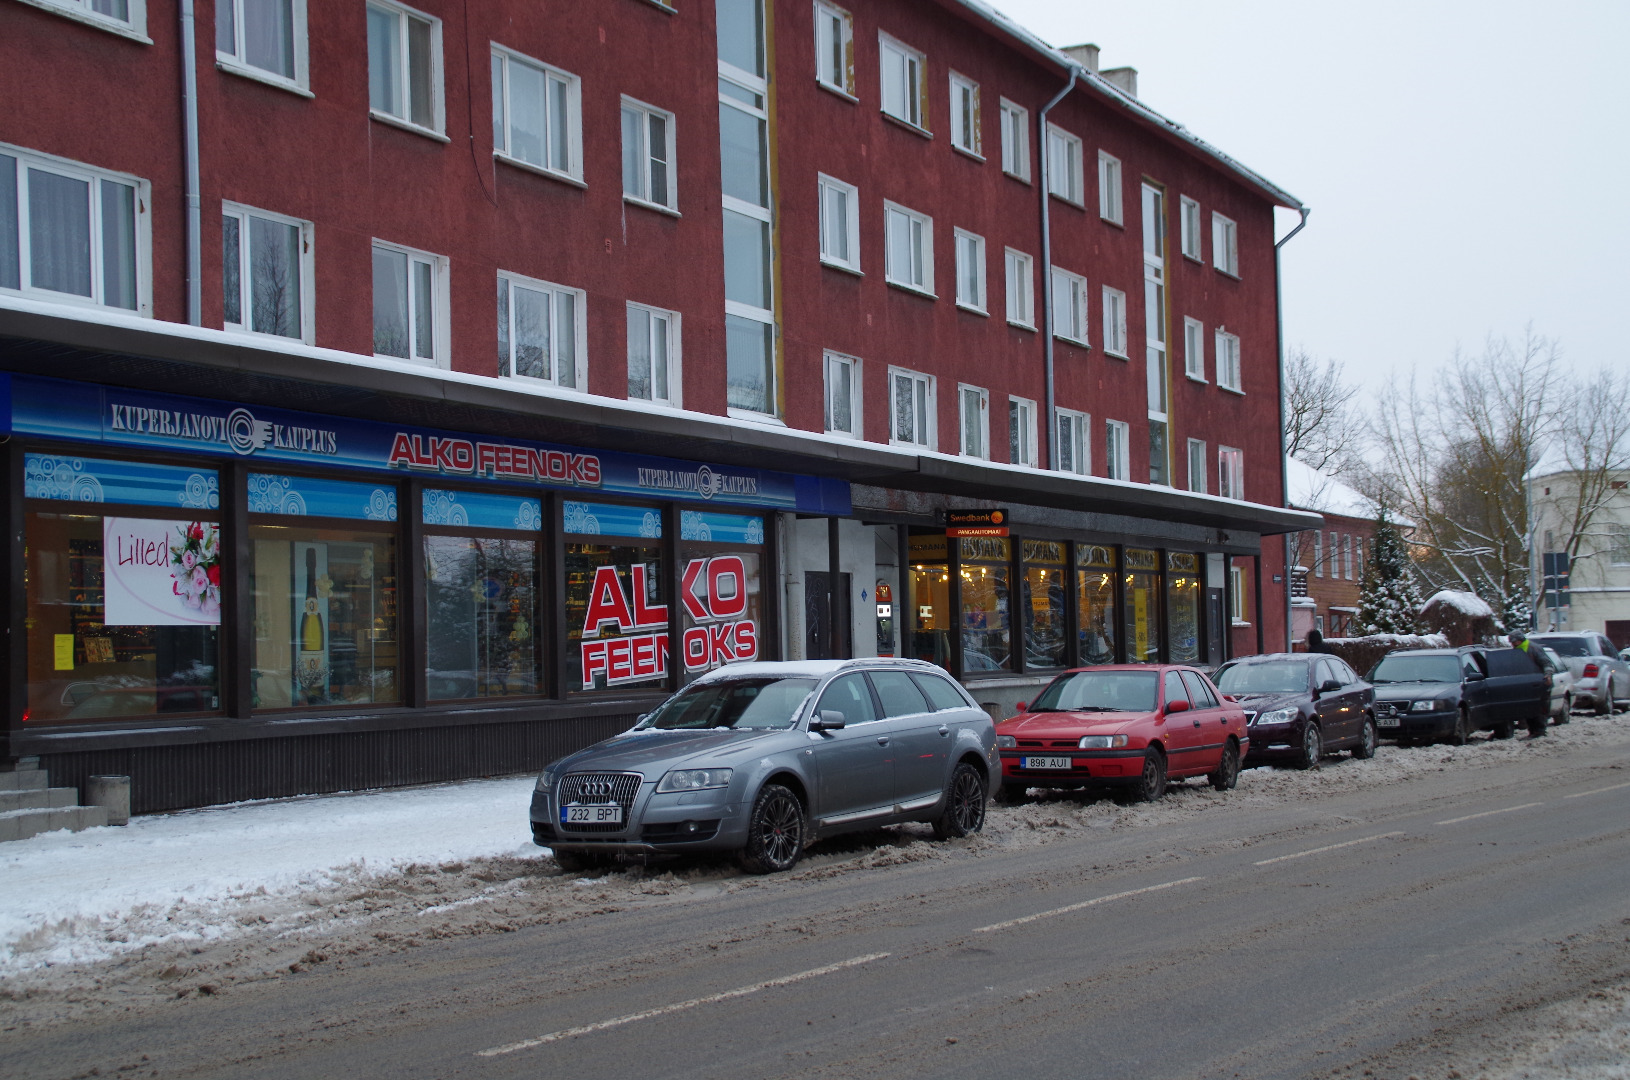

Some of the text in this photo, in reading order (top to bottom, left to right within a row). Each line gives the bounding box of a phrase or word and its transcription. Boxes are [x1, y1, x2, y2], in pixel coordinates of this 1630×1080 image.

[111, 404, 337, 454] KUPERJANOVI KAUPLUS
[388, 432, 601, 486] ALKO FEENOKS
[638, 467, 758, 494] KUPERJANOVI KAUPLUS
[950, 514, 990, 522] Swedbank
[118, 531, 169, 568] Lilled
[1030, 758, 1046, 768] 898
[1049, 758, 1067, 768] AUI
[571, 808, 619, 821] 232 BPT
